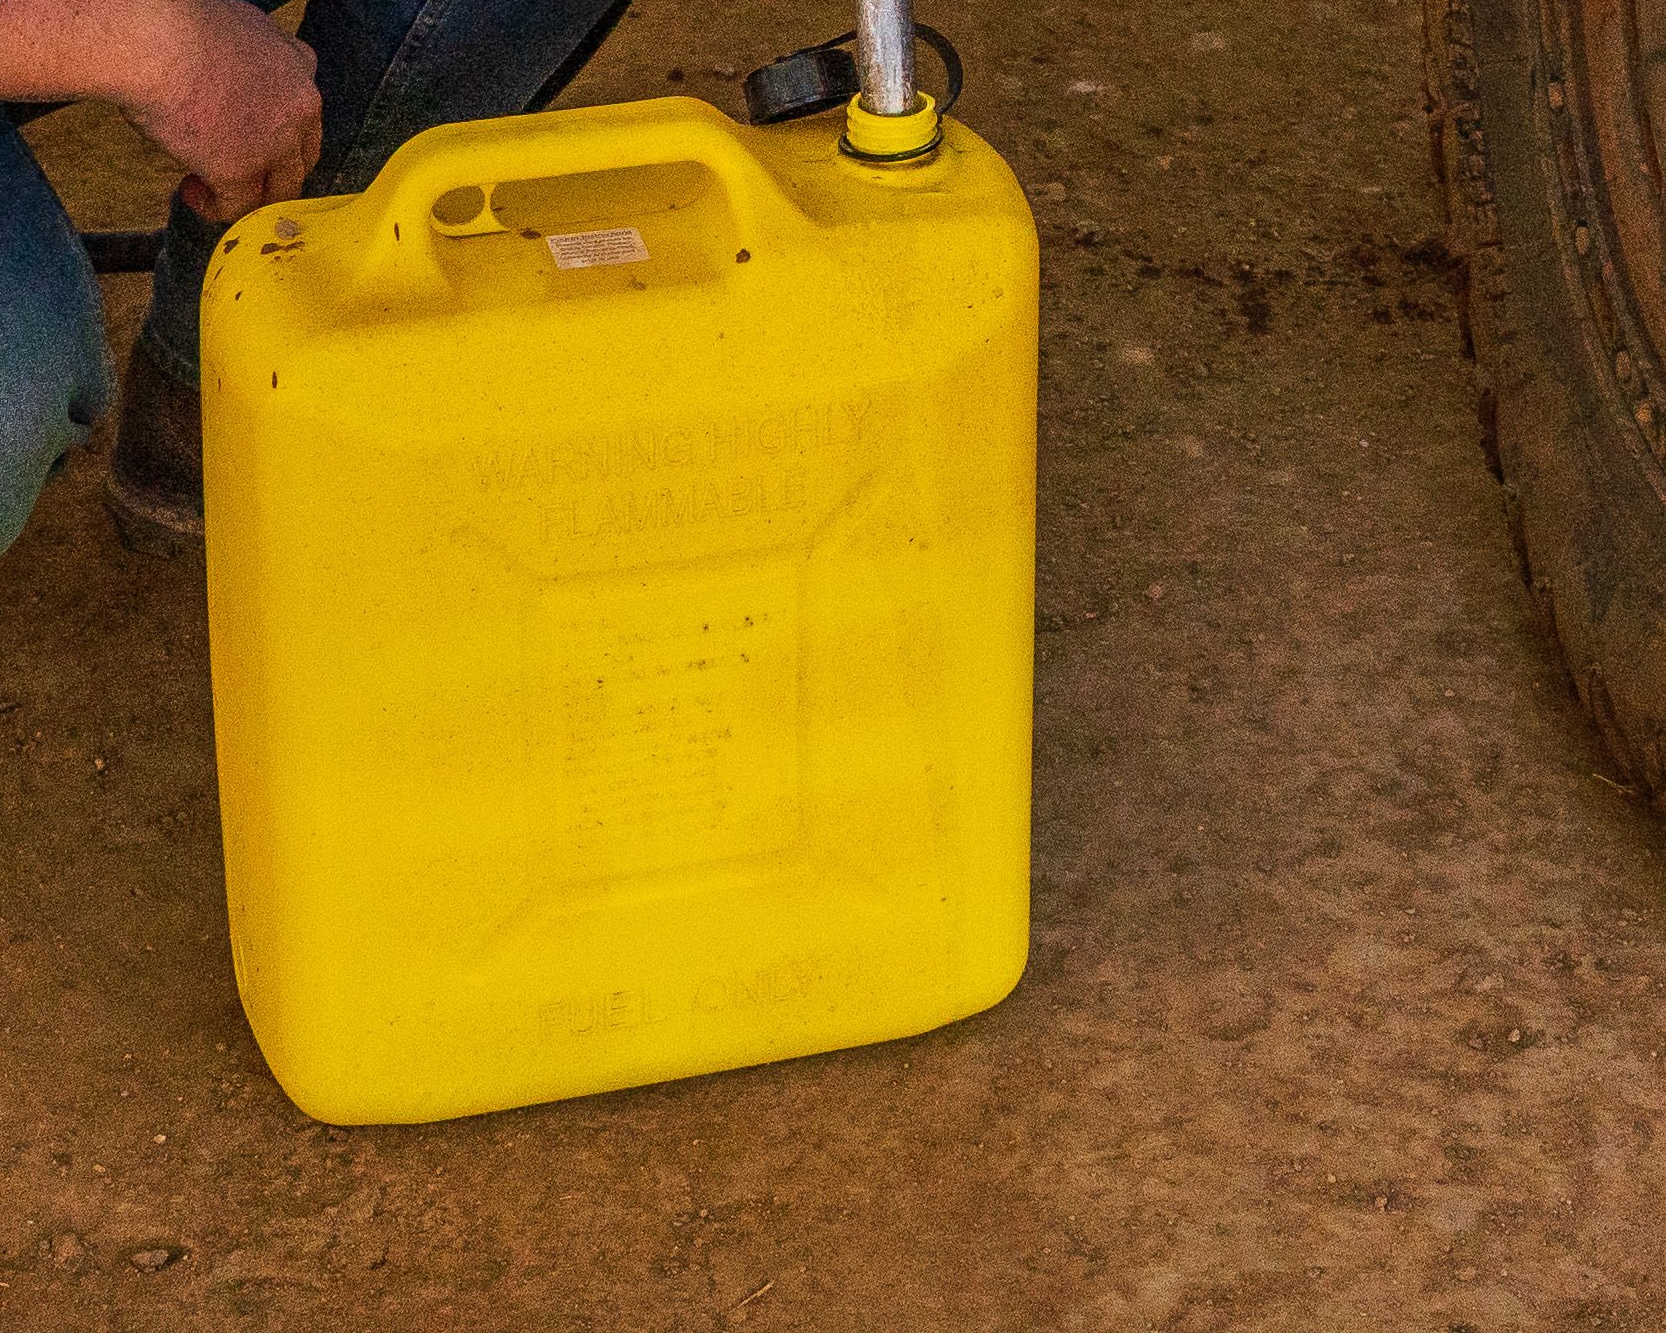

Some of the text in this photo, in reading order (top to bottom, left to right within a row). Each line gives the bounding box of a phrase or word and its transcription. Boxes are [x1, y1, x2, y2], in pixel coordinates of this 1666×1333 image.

[471, 398, 874, 490] WARNING HIGHLY
[538, 466, 809, 543] FLAMMABLE
[536, 985, 669, 1041] FUEL
